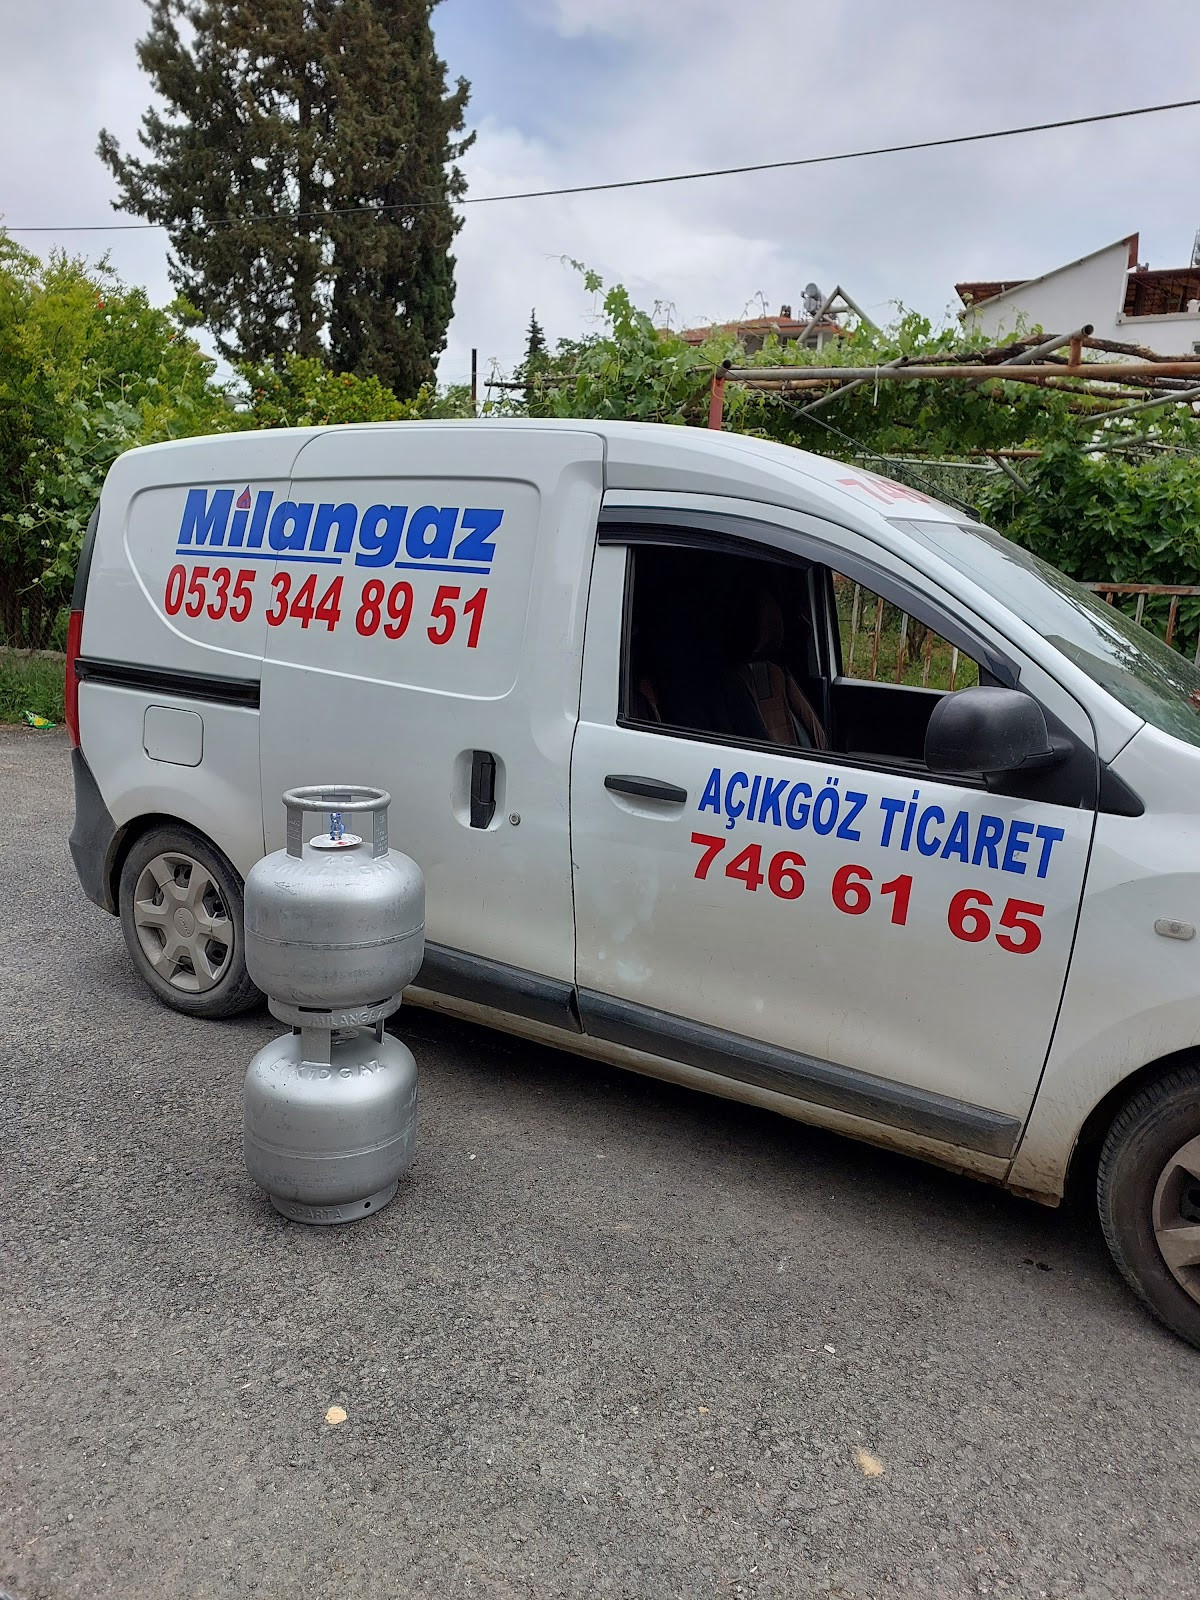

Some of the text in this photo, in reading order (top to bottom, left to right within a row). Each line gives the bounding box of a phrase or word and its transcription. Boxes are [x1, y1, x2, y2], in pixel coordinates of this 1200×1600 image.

[177, 485, 504, 568] Milangaz
[164, 564, 488, 649] 0535 344 89 51
[697, 767, 1065, 879] AÇIKGÖZ TİCARET
[690, 831, 1045, 955] 746 61 65
